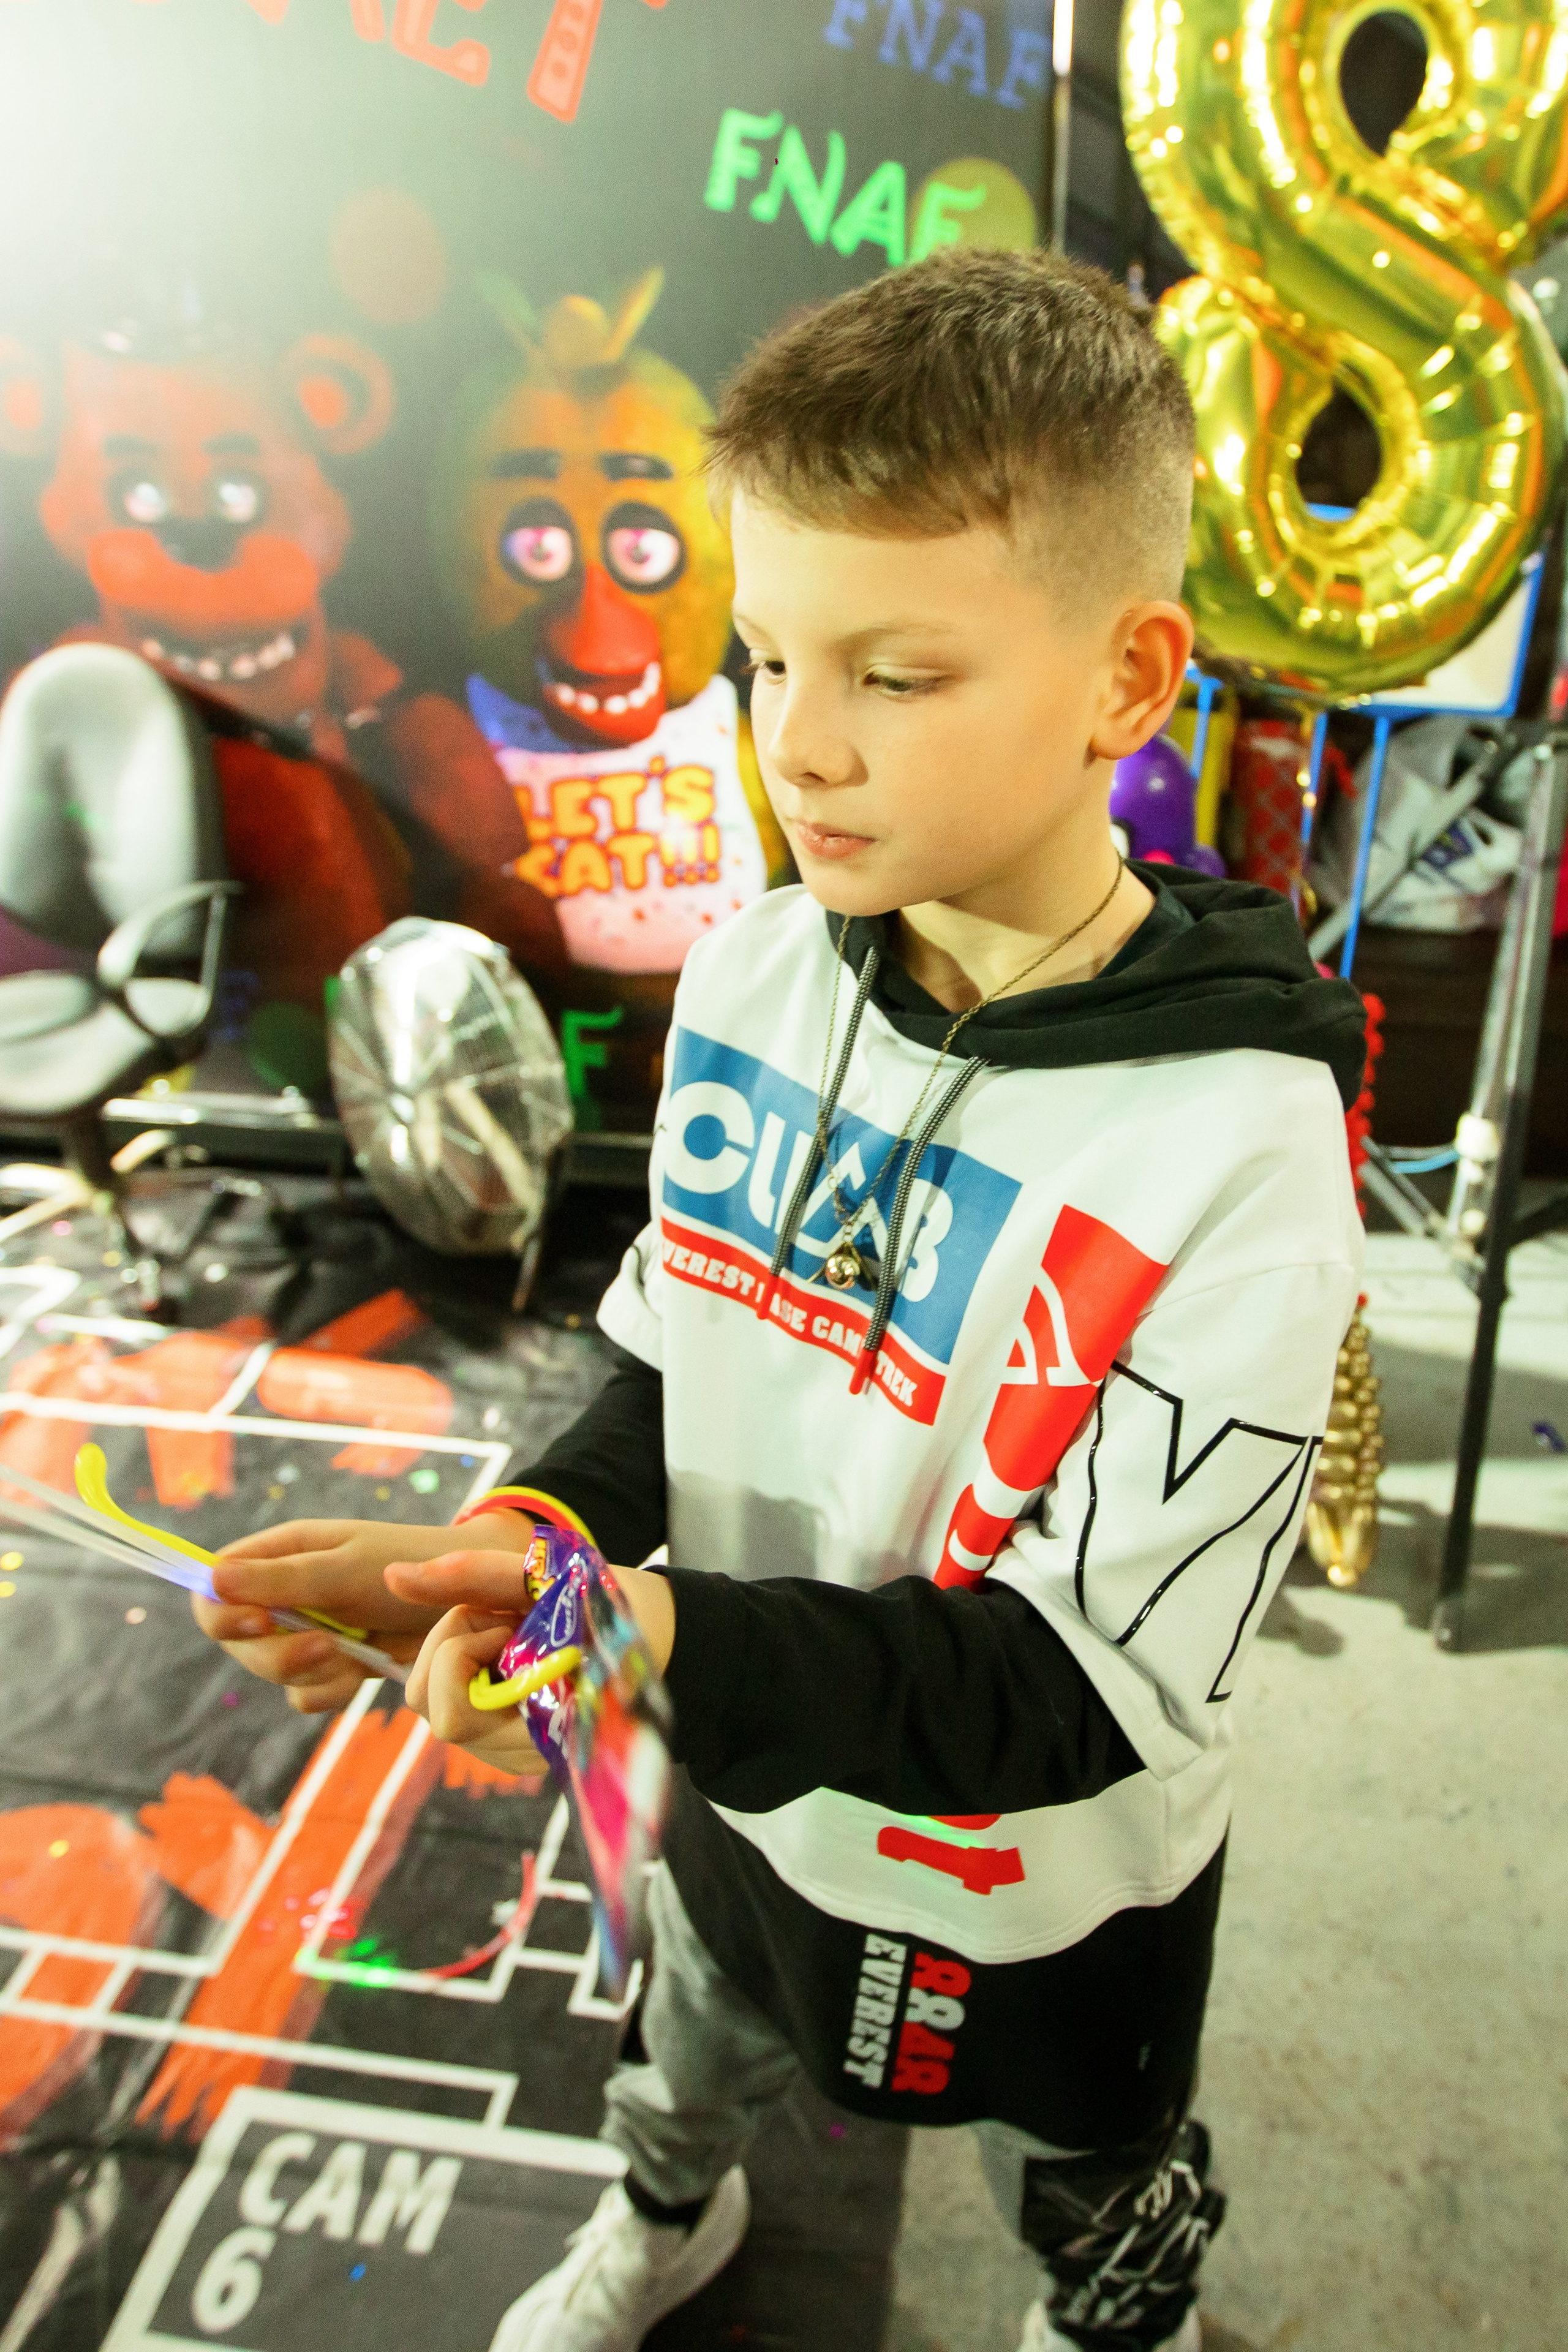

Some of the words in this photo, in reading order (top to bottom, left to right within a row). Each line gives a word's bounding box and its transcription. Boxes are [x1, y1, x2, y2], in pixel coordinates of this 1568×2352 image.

[703, 107, 987, 267] FNAF
[842, 1932, 908, 2090] EVEREST
[239, 2132, 464, 2256] CAM
[190, 2224, 277, 2335] 6
